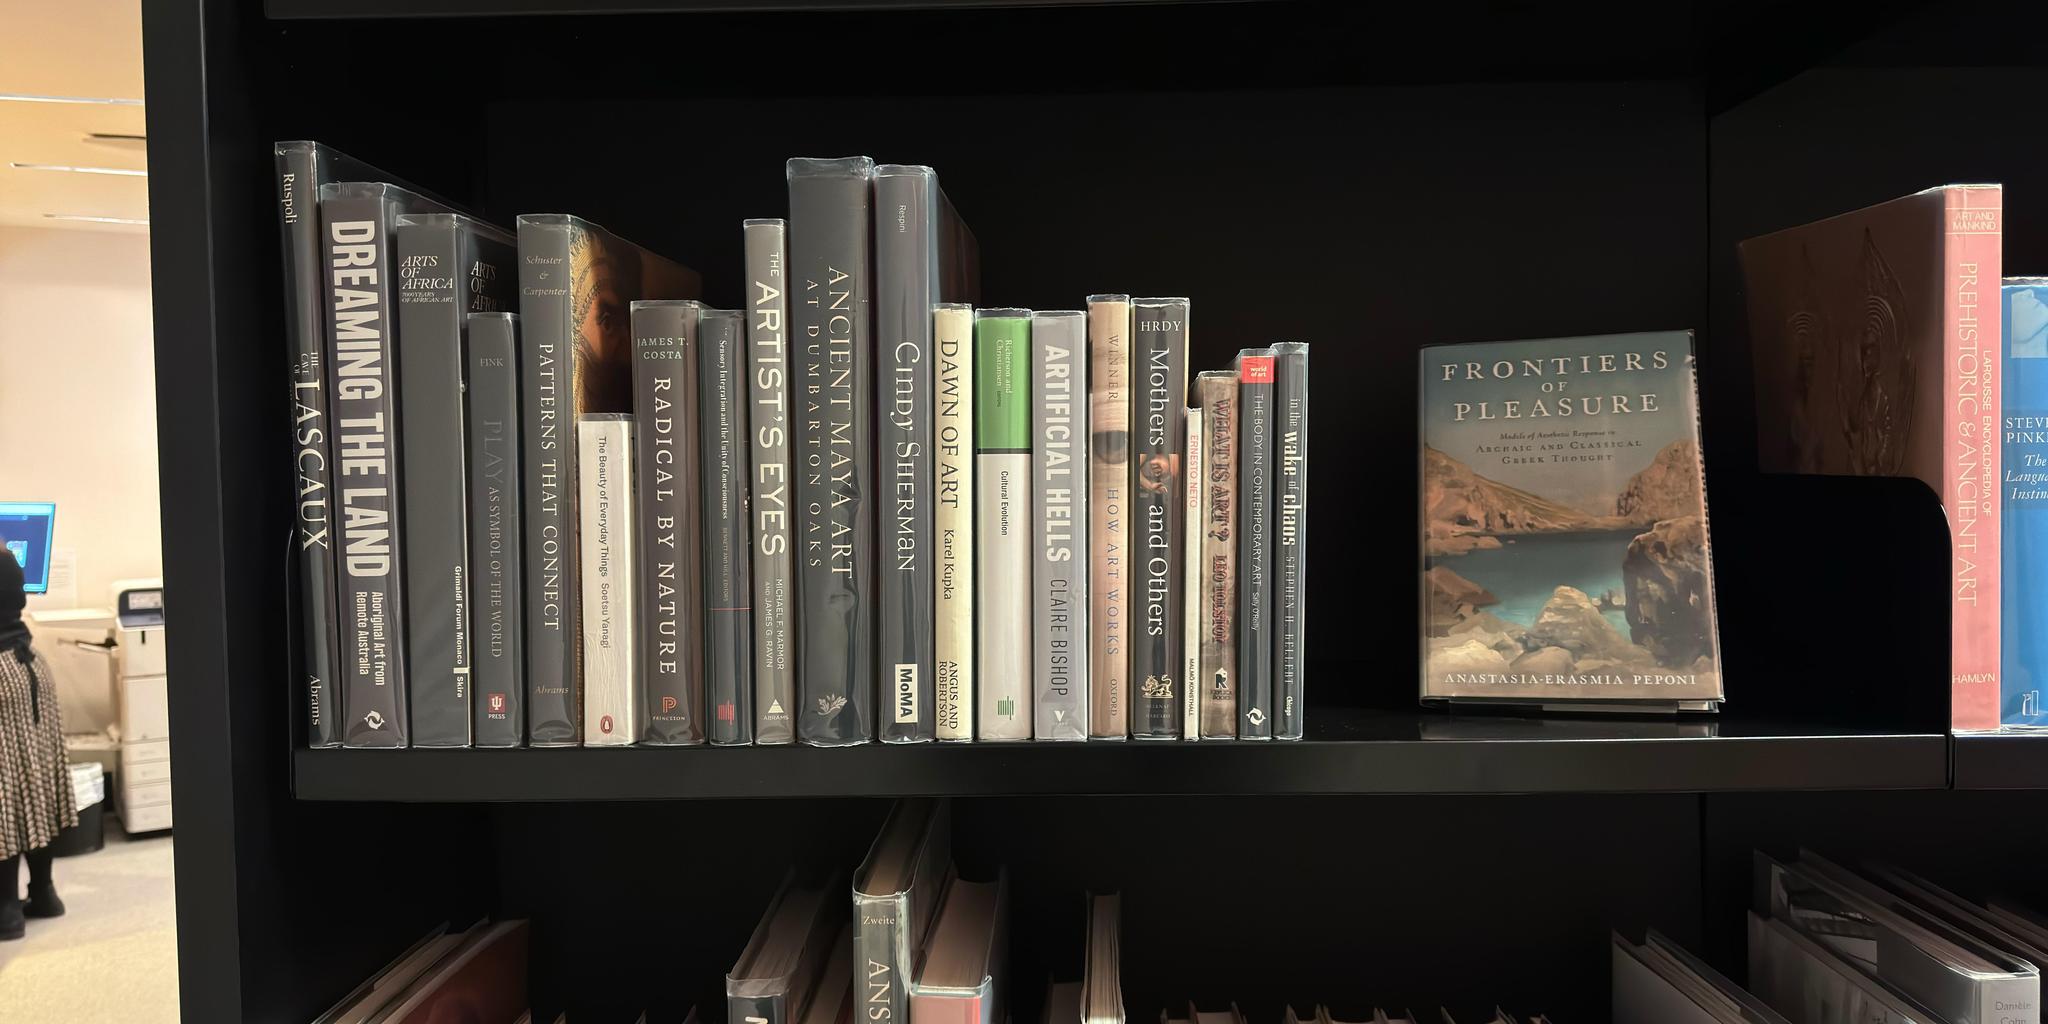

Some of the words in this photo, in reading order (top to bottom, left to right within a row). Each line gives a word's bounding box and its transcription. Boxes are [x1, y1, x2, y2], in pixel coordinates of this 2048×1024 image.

[282, 173, 298, 225] Ruspoli
[1956, 211, 1974, 221] ART
[1975, 211, 1995, 221] AND
[1952, 221, 1996, 231] MANKIND
[401, 255, 438, 267] ARTS
[401, 267, 421, 279] OF
[770, 251, 780, 277] THE
[402, 278, 453, 290] AFRICA
[523, 286, 568, 299] Carpenter
[807, 279, 820, 308] AT
[331, 220, 384, 400] DREAMING
[1141, 320, 1181, 332] HRDY
[637, 338, 673, 348] JAMES
[678, 337, 689, 346] T.
[643, 351, 682, 360] COSTA
[717, 339, 728, 369] Sensory
[828, 265, 852, 410] ANCIENT
[1957, 262, 1978, 416] PREHISTORIC
[480, 358, 504, 367] FINK
[755, 280, 784, 448] ARTIST'S
[940, 339, 959, 418] DAWN
[1108, 334, 1119, 400] WINNER
[1440, 351, 1668, 381] FRONTIERS
[1982, 350, 1992, 411] LAROUSSE
[538, 343, 556, 450] PATTERNS
[718, 370, 728, 412] Integration
[1005, 380, 1013, 394] and
[1149, 348, 1170, 446] Mothers
[1254, 394, 1264, 416] THE
[1290, 399, 1301, 409] in
[1541, 382, 1568, 393] OF
[807, 325, 821, 486] DUMBARTON
[1045, 345, 1071, 481] ARTIFICIAL
[1289, 410, 1301, 427] the
[1453, 394, 1659, 421] PLEASURE
[340, 412, 386, 476] THE
[598, 436, 607, 454] The
[654, 377, 674, 502] RADICAL
[721, 426, 729, 438] the
[940, 426, 959, 456] OF
[1253, 418, 1264, 450] BODY
[1958, 421, 1976, 438] &
[294, 378, 328, 551] LASCAUX
[484, 420, 503, 486] PLAY
[719, 439, 729, 459] Unity
[722, 460, 730, 469] of
[830, 422, 852, 509] MAYA
[1190, 435, 1199, 480] ERNESTO
[1253, 453, 1263, 465] IN
[1284, 431, 1303, 476] wake
[1982, 415, 1992, 499] ENCYCLOPEDIA
[2024, 453, 2047, 467] The
[541, 459, 557, 516] THAT
[598, 455, 608, 490] Beauty
[940, 463, 959, 509] ART
[1001, 470, 1009, 500] Cultural
[1288, 480, 1300, 491] of
[489, 487, 500, 502] AS
[600, 491, 609, 501] of
[722, 469, 730, 519] Consciousness
[760, 463, 786, 556] EYES
[1107, 489, 1119, 533] HOW
[1189, 482, 1198, 508] NETO
[1958, 440, 1977, 554] ANCIENT
[1982, 501, 1992, 517] OF
[343, 487, 390, 577] LAND
[489, 503, 501, 558] SYMBOL
[598, 502, 609, 545] Everyday
[657, 516, 674, 549] BY
[1001, 502, 1009, 536] Evolution
[1046, 488, 1072, 562] HELLS
[1148, 505, 1168, 549] and
[1252, 468, 1264, 561] CONTEMPORARY
[1282, 494, 1302, 546] chaos
[809, 502, 822, 567] OAKS
[831, 520, 852, 579] ART
[944, 529, 955, 560] Karel
[490, 560, 501, 577] OF
[543, 526, 559, 630] CONNECT
[599, 546, 610, 577] Things
[1107, 544, 1119, 578] ART
[1252, 565, 1262, 587] ART
[454, 566, 462, 601] Grimaldi
[490, 580, 502, 606] THE
[601, 583, 610, 616] Soetsu
[776, 578, 784, 619] MICHAEL
[942, 563, 955, 600] Kupka
[1148, 557, 1168, 636] Others
[1284, 556, 1295, 608] STEPHEN
[1958, 557, 1977, 607] ART
[355, 591, 368, 629] Remote
[371, 591, 385, 639] Aboriginal
[455, 603, 463, 631] Forum
[658, 562, 677, 674] NATURE
[765, 597, 773, 627] JAMES
[1050, 579, 1068, 632] CLAIRE
[1107, 589, 1119, 655] WORKS
[374, 640, 385, 658] Art
[456, 632, 464, 665] Monaco
[491, 608, 502, 658] WORLD
[600, 616, 611, 649] Yanagi
[776, 630, 785, 670] MARMOR
[357, 630, 370, 675] Australia
[1050, 641, 1068, 696] BISHOP
[375, 660, 386, 686] from
[949, 661, 958, 703] ANGUS
[1445, 673, 1624, 685] ANASTASIA-ERASMIA
[1633, 674, 1697, 686] PEPONI
[1952, 673, 1996, 684] HAMLYN
[310, 674, 322, 726] Abrams
[900, 668, 913, 718] MoMA
[939, 661, 948, 727] ROBERTSON
[949, 704, 958, 730] AND
[863, 916, 895, 925] Zweite
[868, 957, 892, 1024] ANS
